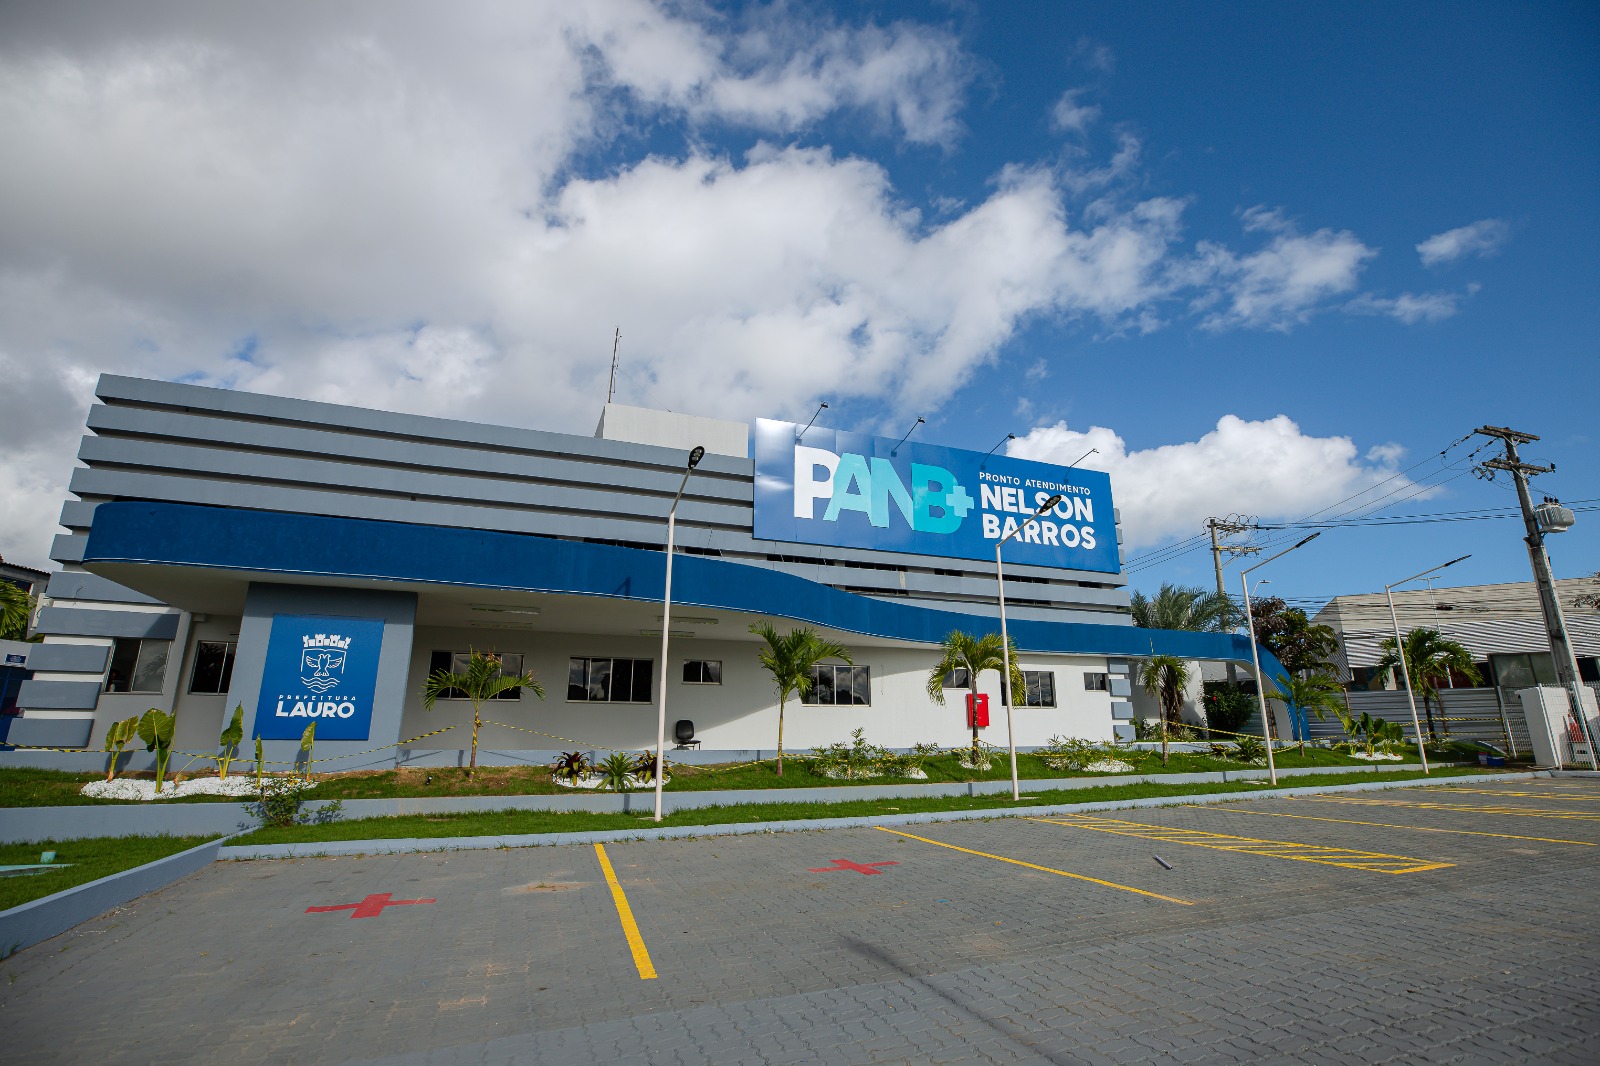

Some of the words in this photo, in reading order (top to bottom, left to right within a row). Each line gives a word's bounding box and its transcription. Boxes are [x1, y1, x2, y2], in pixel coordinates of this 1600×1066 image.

[979, 471, 1020, 485] PRONTO
[1025, 479, 1091, 495] ATENDIMENTO
[980, 483, 1094, 522] NELSON
[982, 513, 1096, 550] BARROS
[275, 700, 355, 719] LAURO
